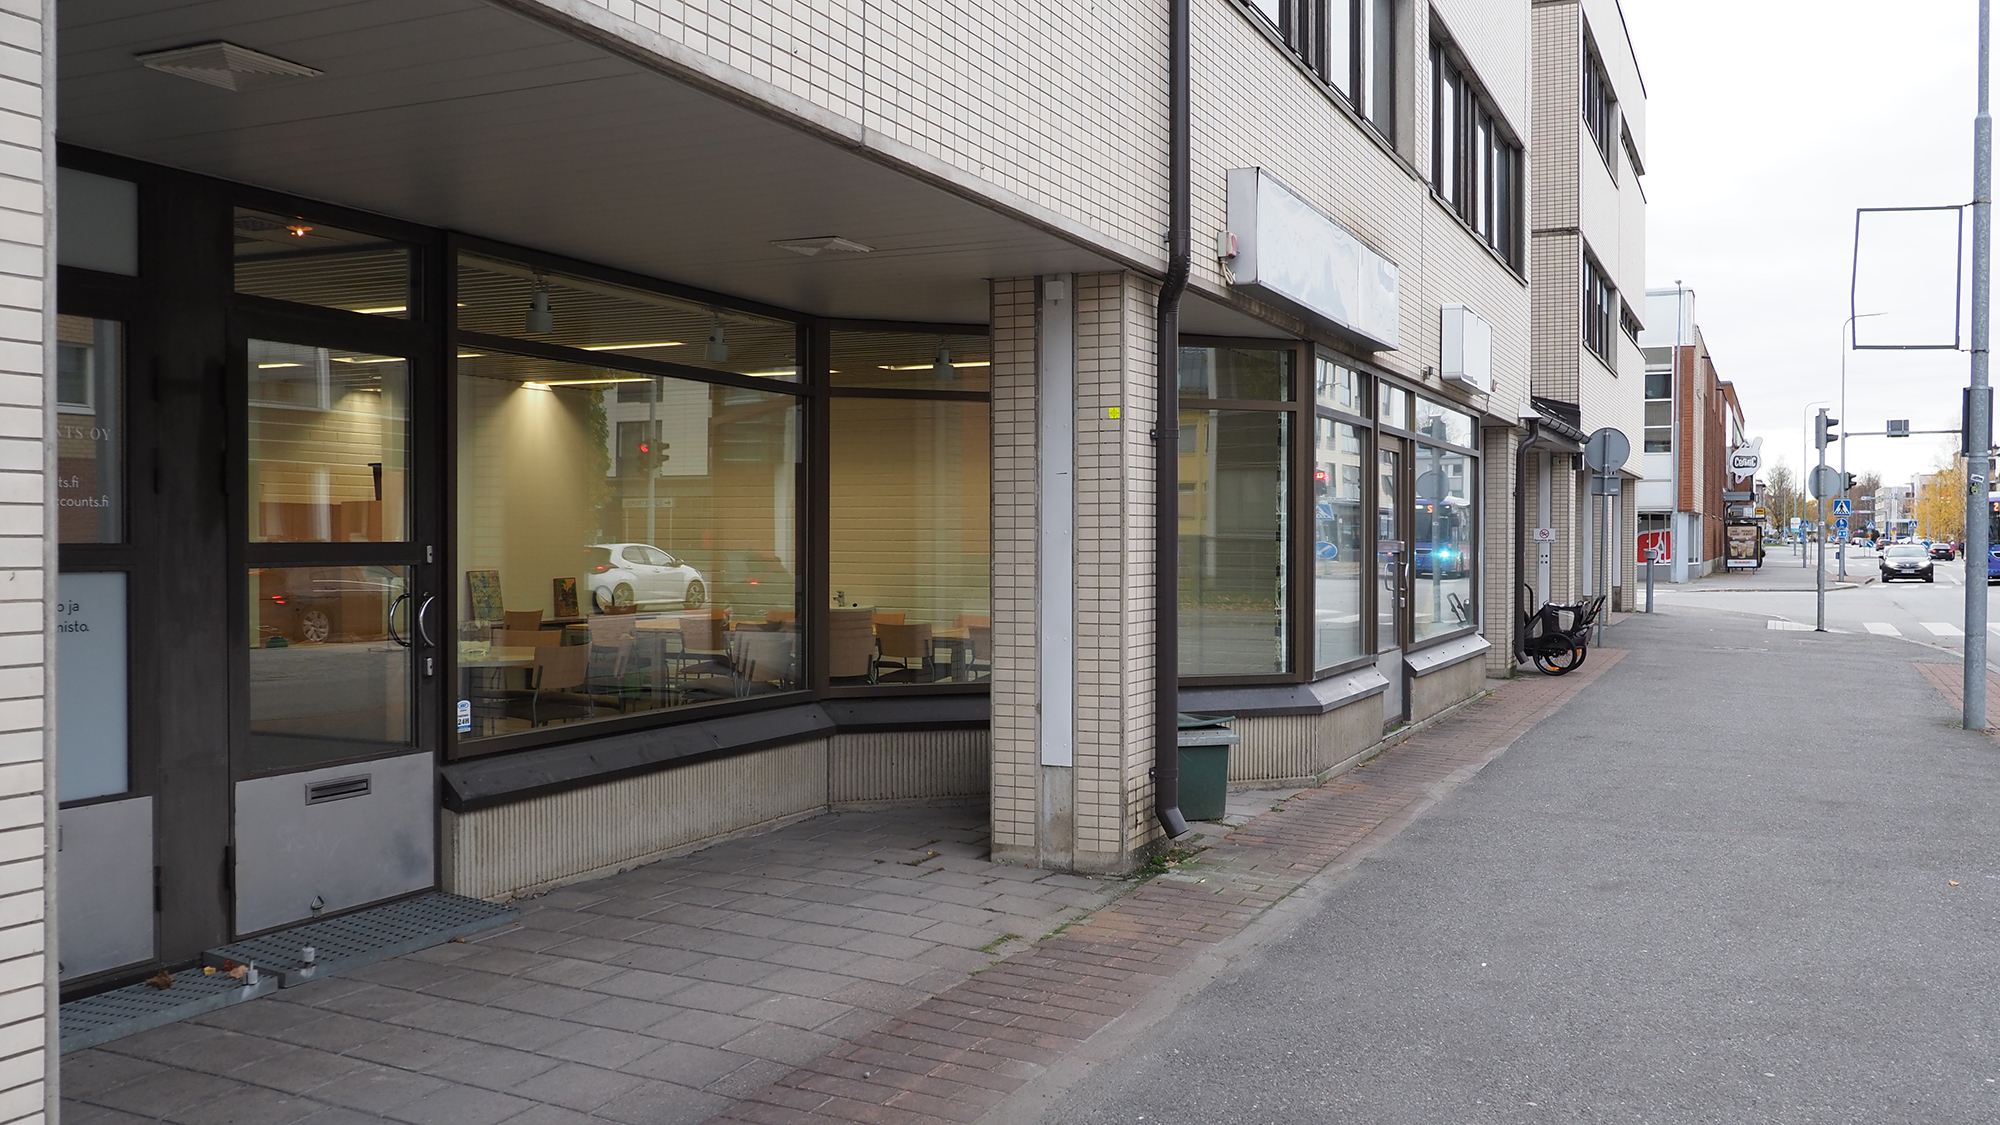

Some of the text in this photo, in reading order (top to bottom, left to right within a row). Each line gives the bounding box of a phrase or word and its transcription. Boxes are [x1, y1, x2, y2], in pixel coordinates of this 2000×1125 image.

[89, 427, 111, 441] OY
[58, 475, 79, 488] ts.fi
[58, 494, 109, 507] counts.fi
[67, 599, 80, 616] ja
